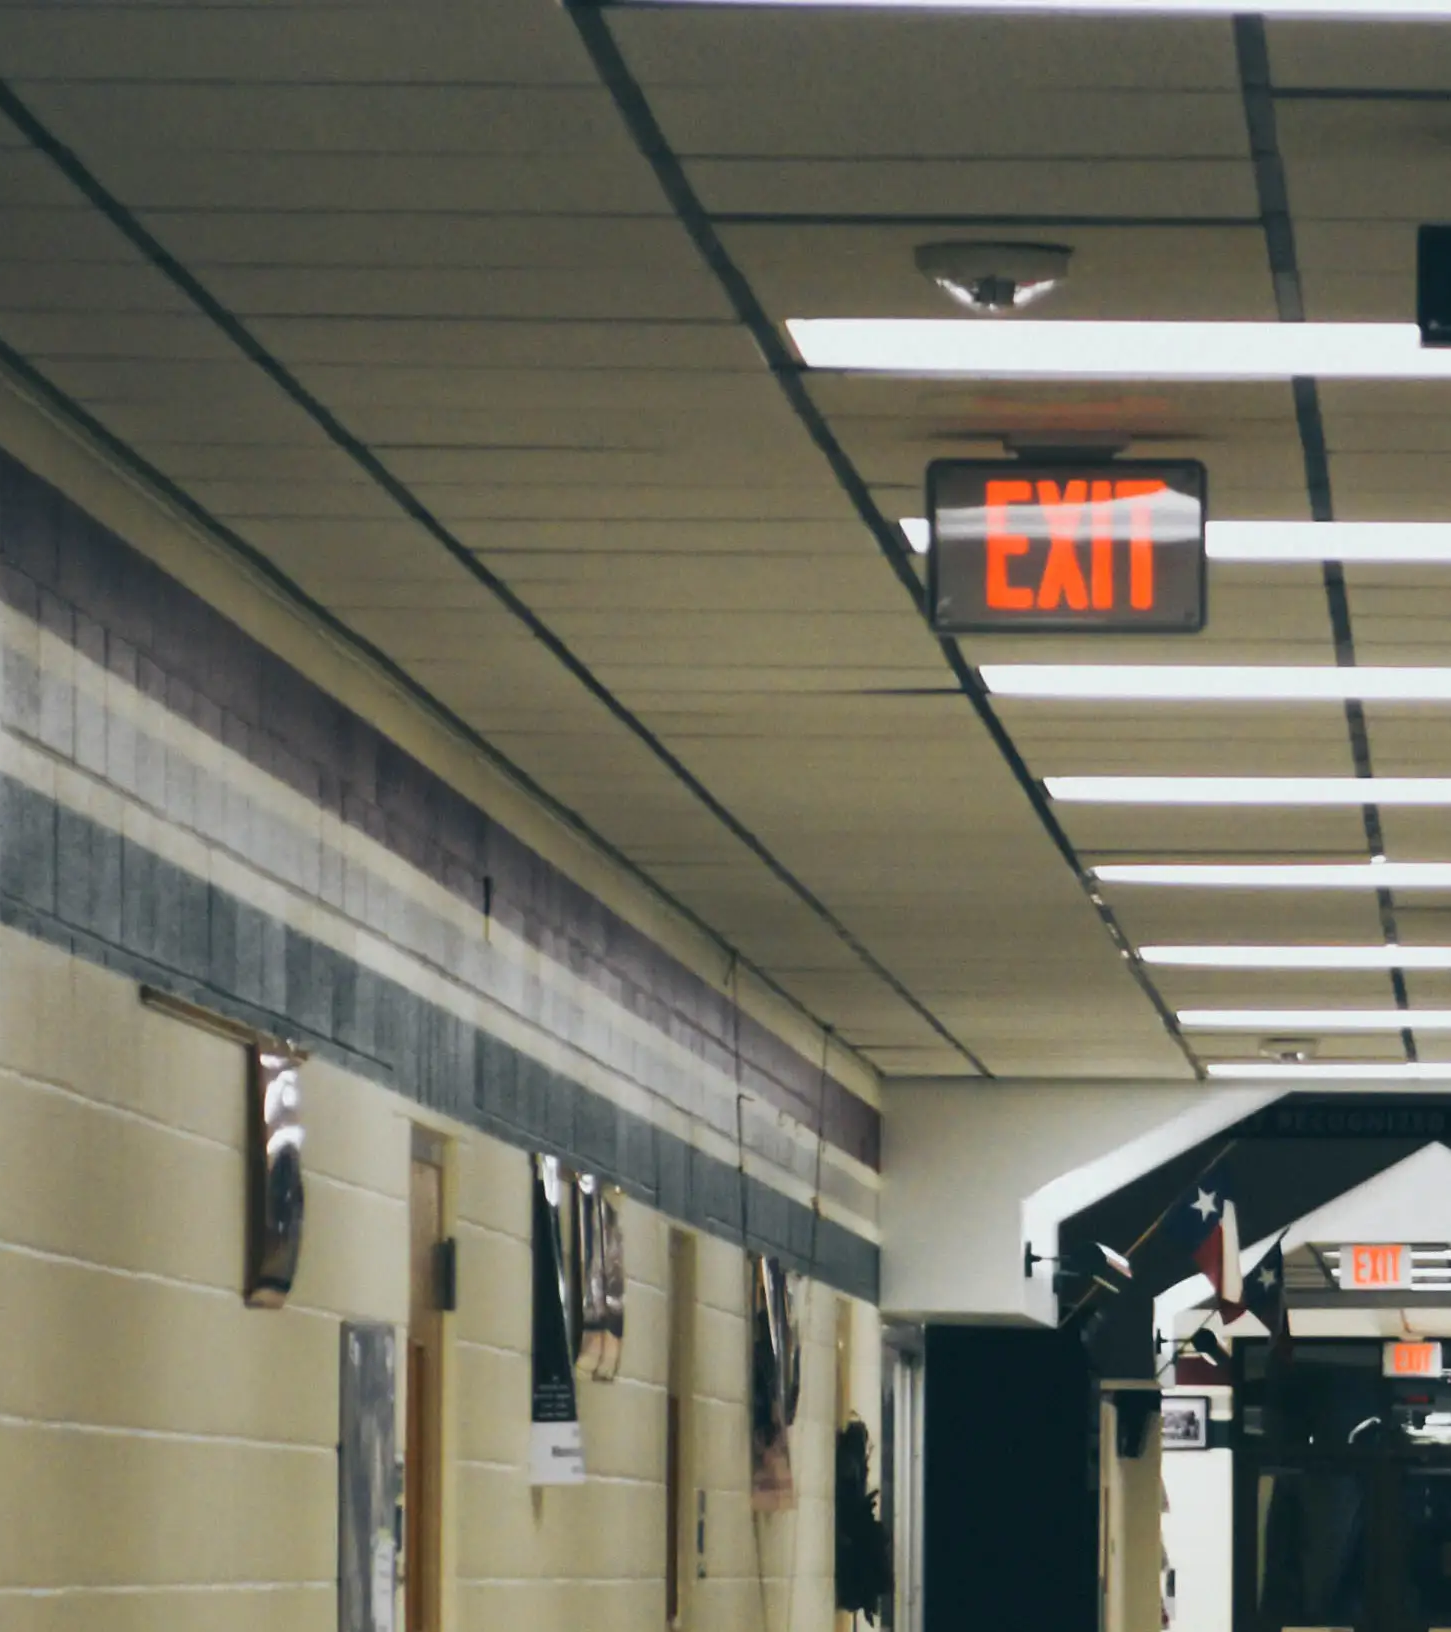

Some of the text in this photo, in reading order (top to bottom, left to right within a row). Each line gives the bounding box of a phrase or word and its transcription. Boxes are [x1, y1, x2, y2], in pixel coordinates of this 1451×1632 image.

[985, 480, 1167, 609] EXIT
[1353, 1245, 1402, 1284] EXIT
[1394, 1342, 1432, 1372] EXIT
